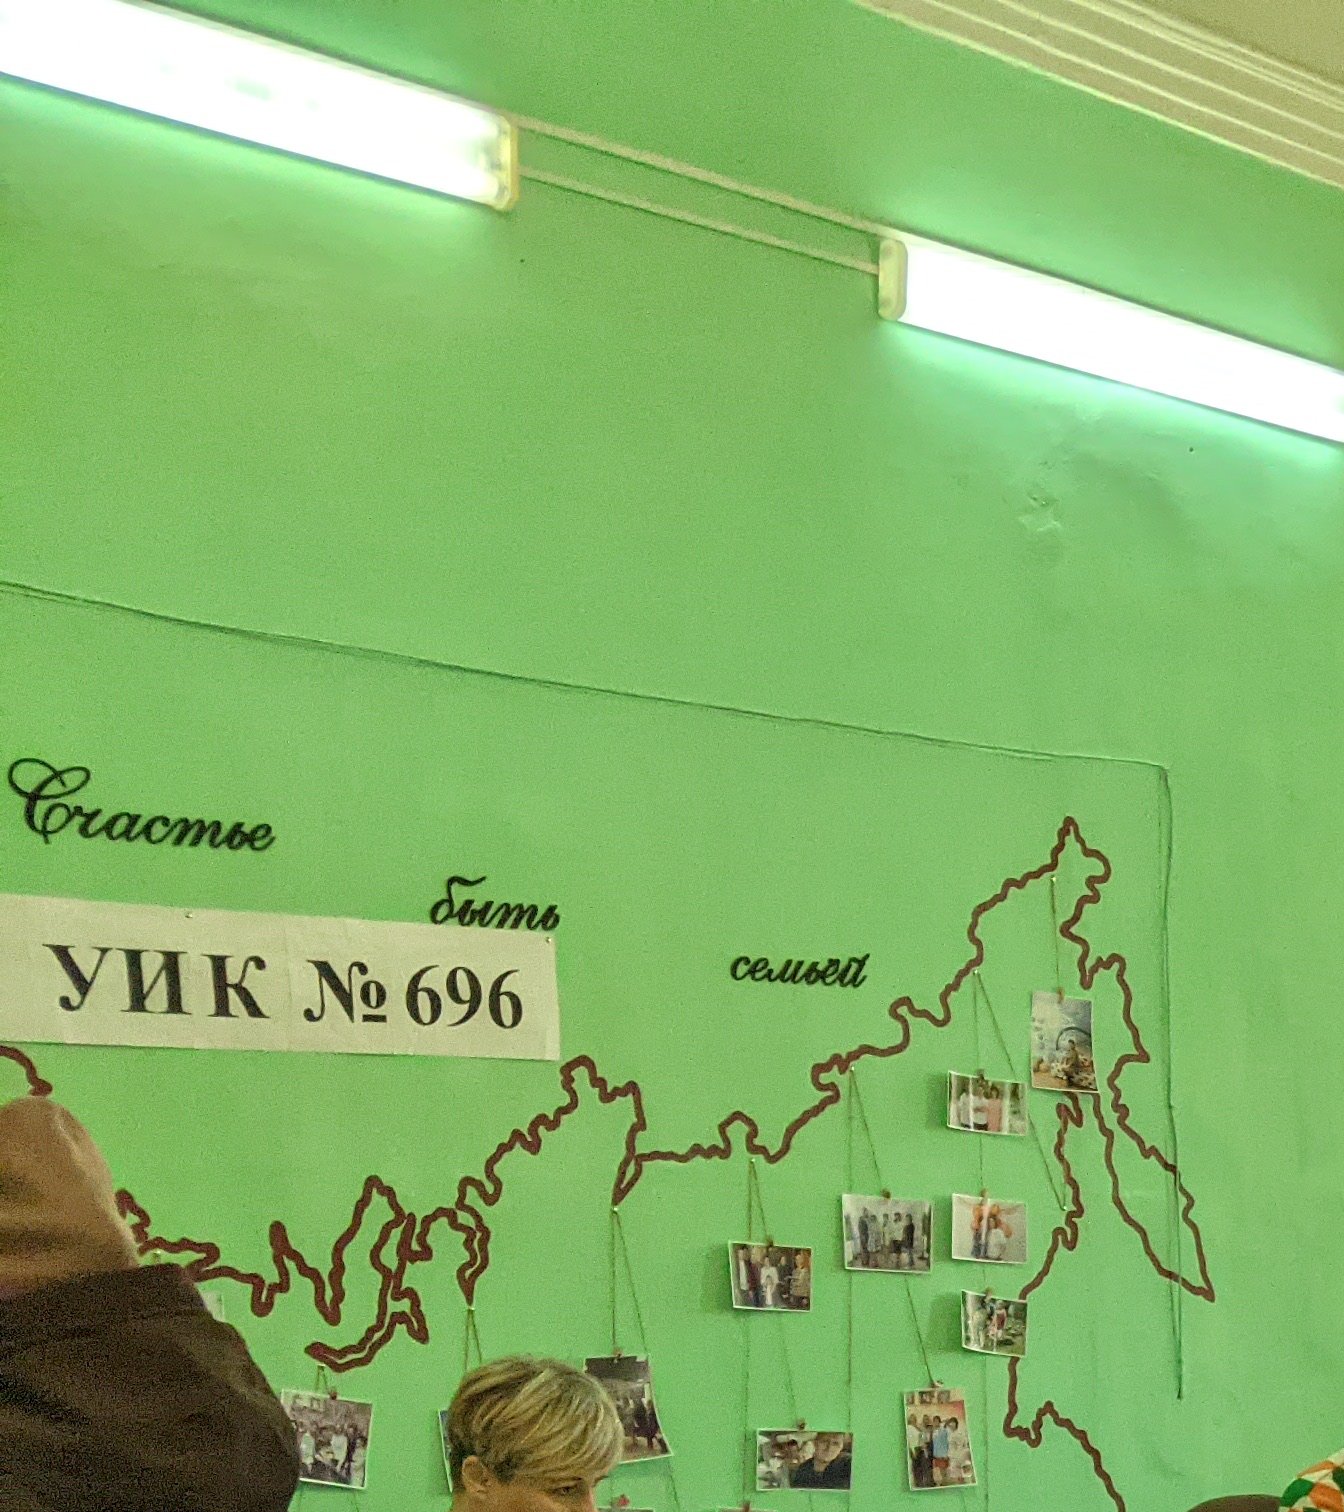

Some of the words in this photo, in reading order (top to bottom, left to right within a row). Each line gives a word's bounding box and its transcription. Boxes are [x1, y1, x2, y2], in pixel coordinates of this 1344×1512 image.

[7, 757, 276, 853] Счастье
[429, 876, 561, 932] быть
[42, 943, 271, 1020] УИК
